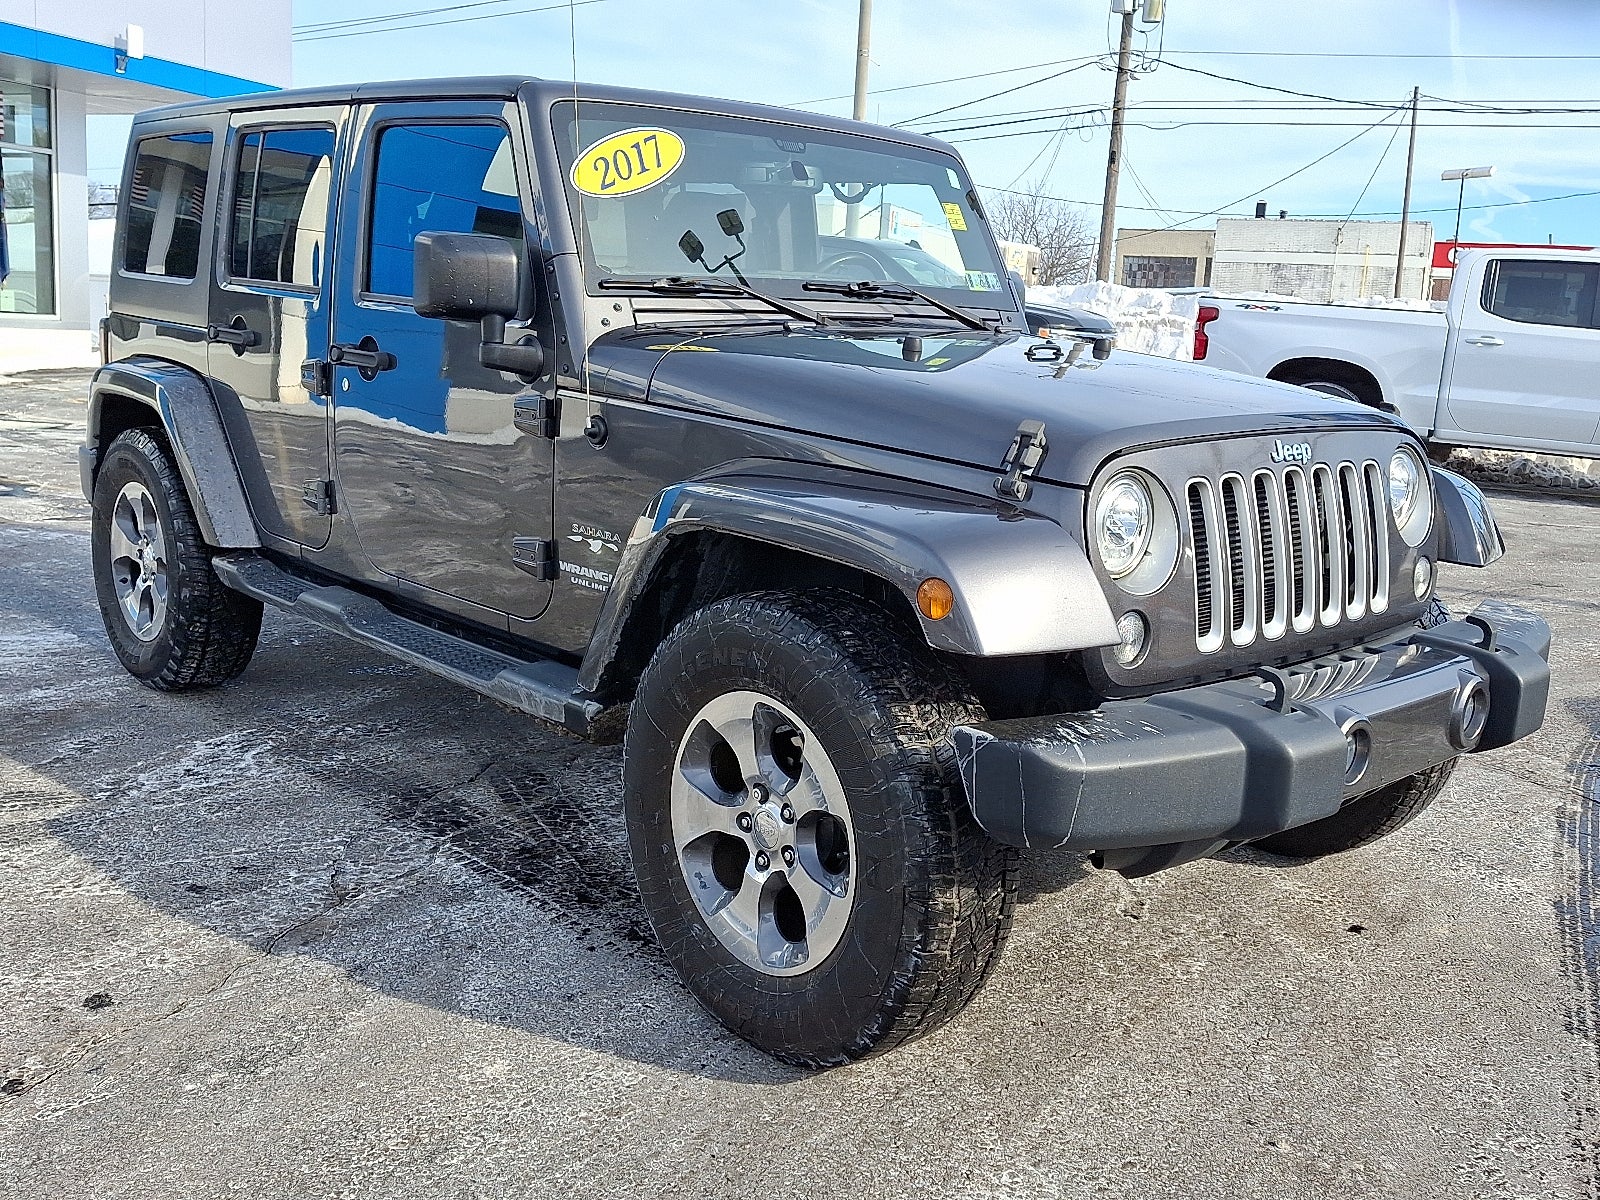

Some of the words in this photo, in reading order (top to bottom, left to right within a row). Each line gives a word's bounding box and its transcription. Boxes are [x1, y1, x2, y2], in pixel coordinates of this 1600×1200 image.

[593, 134, 662, 190] 2017
[1269, 439, 1312, 465] Jeep
[571, 523, 621, 543] SAHARA
